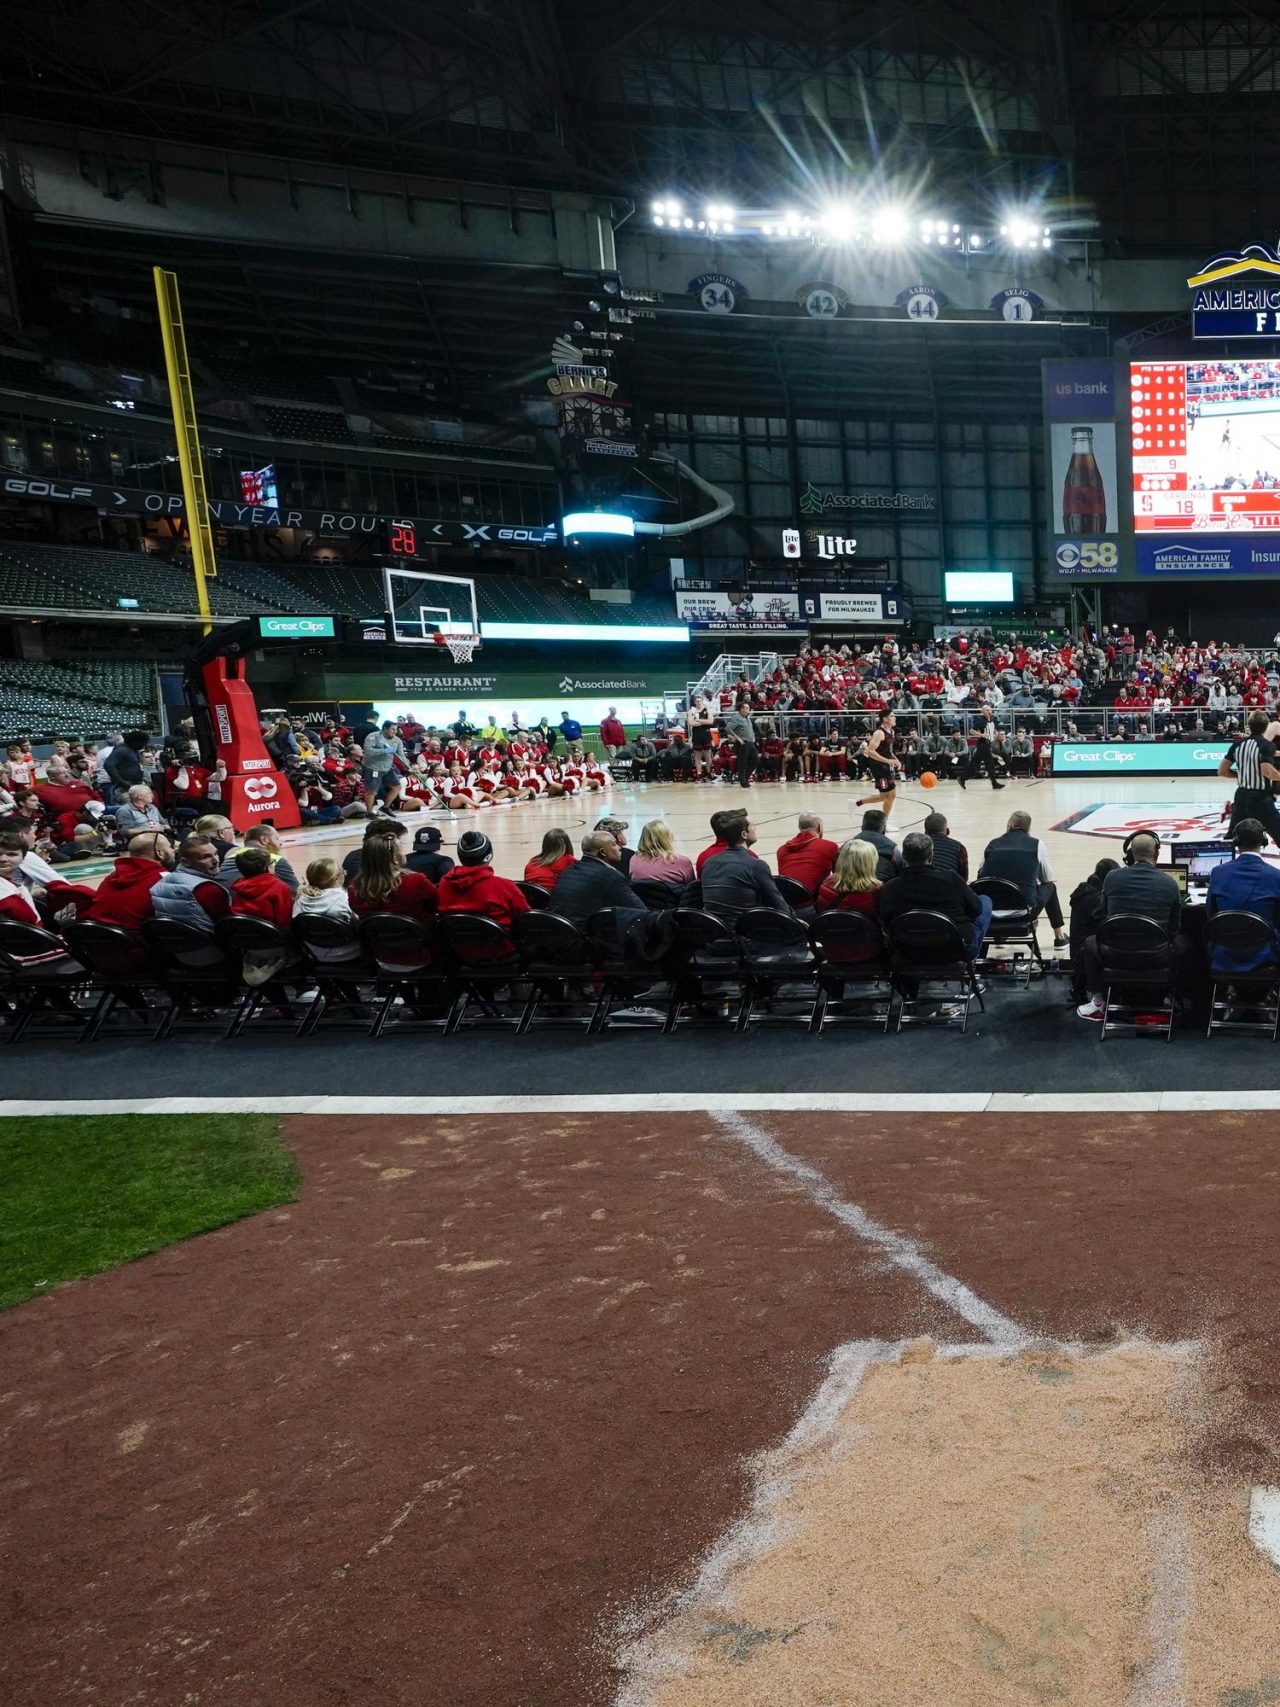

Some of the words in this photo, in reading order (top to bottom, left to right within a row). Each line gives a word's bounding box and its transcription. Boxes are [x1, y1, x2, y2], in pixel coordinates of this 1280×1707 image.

[698, 275, 736, 287] FINGERS
[908, 287, 935, 295] AARON
[1004, 289, 1029, 297] SELIG
[705, 289, 730, 308] 34
[809, 296, 836, 314] 42
[911, 300, 935, 318] 44
[1013, 303, 1023, 320] 1
[1074, 382, 1107, 395] bank
[1168, 459, 1177, 469] 9
[5, 479, 92, 500] GOLF
[1163, 491, 1207, 499] CARDINAL
[145, 495, 222, 519] OPN
[234, 504, 302, 527] YEAR
[1176, 500, 1194, 513] 18
[391, 527, 416, 554] 28
[498, 529, 558, 542] GOLF
[817, 534, 857, 560] Lite
[1080, 542, 1118, 568] 58
[1200, 554, 1230, 562] FAMILY
[267, 620, 299, 631] Great
[299, 620, 325, 633] Clips
[216, 705, 232, 742] INTERSPORT
[1063, 750, 1101, 762] Great
[1103, 750, 1136, 763] Clips
[1193, 749, 1226, 761] Grea
[247, 801, 281, 813] Aurora
